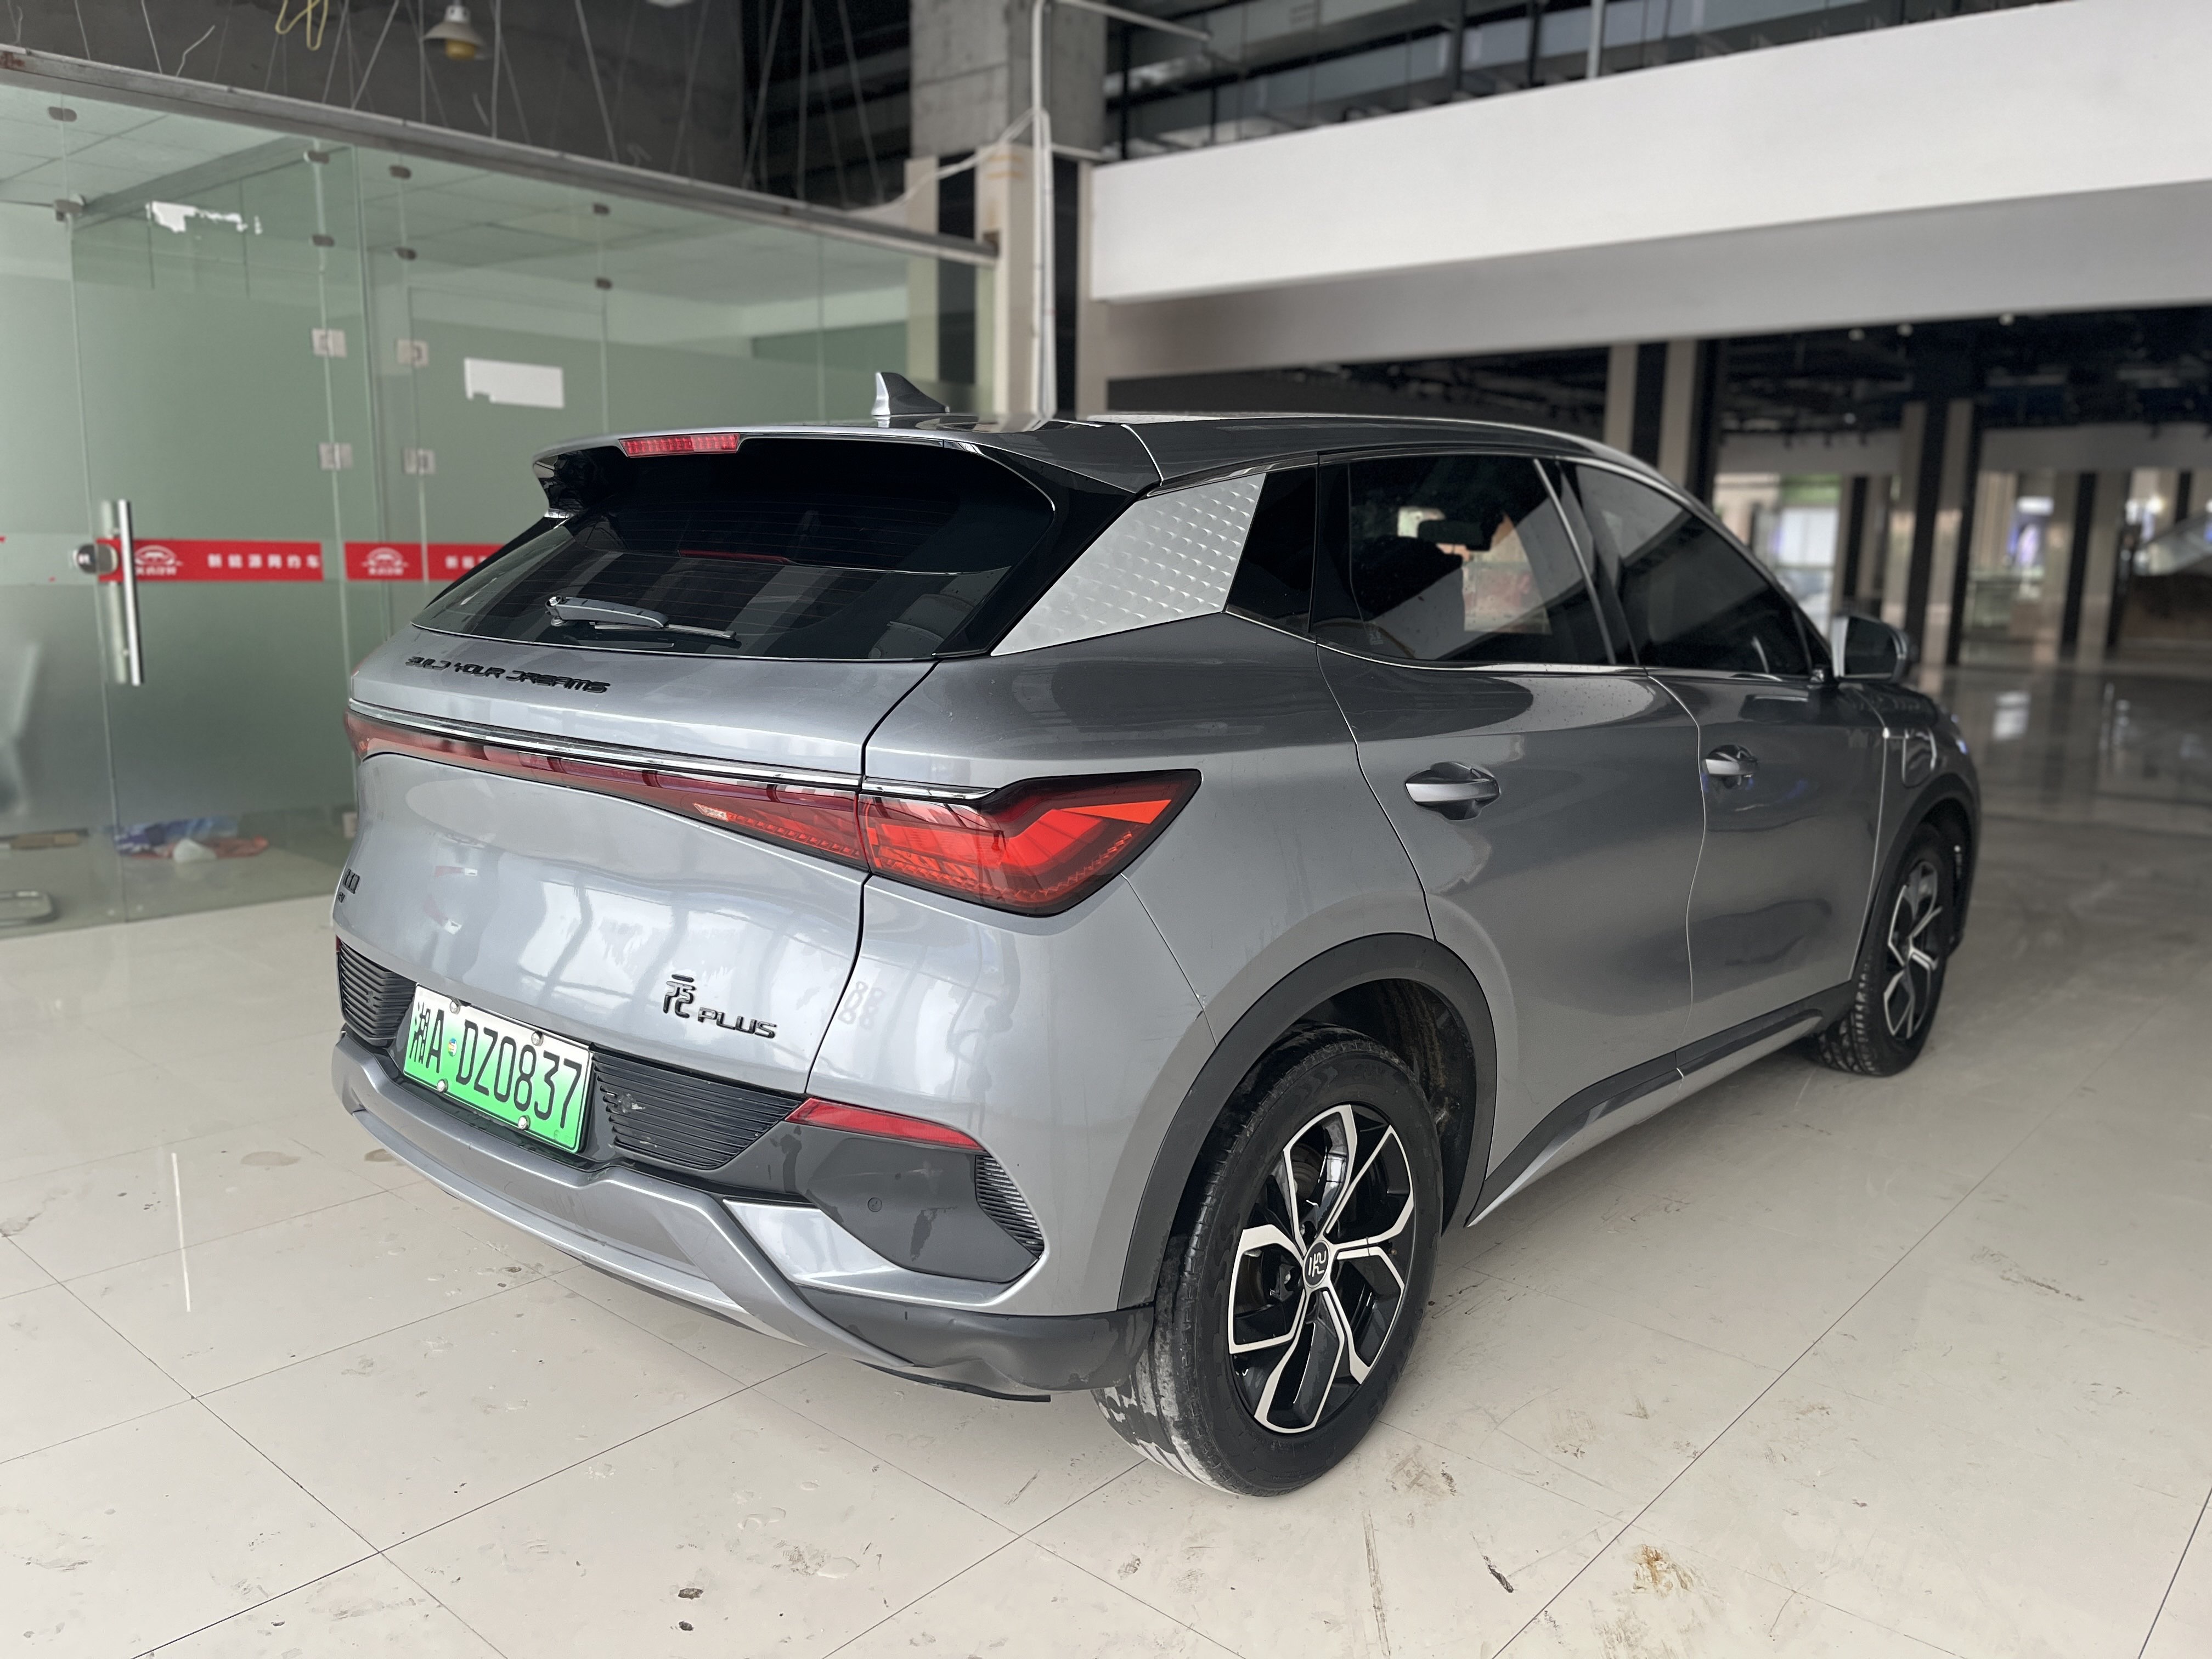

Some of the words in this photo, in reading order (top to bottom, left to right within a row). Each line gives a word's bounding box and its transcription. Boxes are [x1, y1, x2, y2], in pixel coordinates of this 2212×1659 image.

[454, 662, 505, 679] YOUR
[506, 670, 610, 693] DREAMS
[698, 1007, 777, 1039] PLUS
